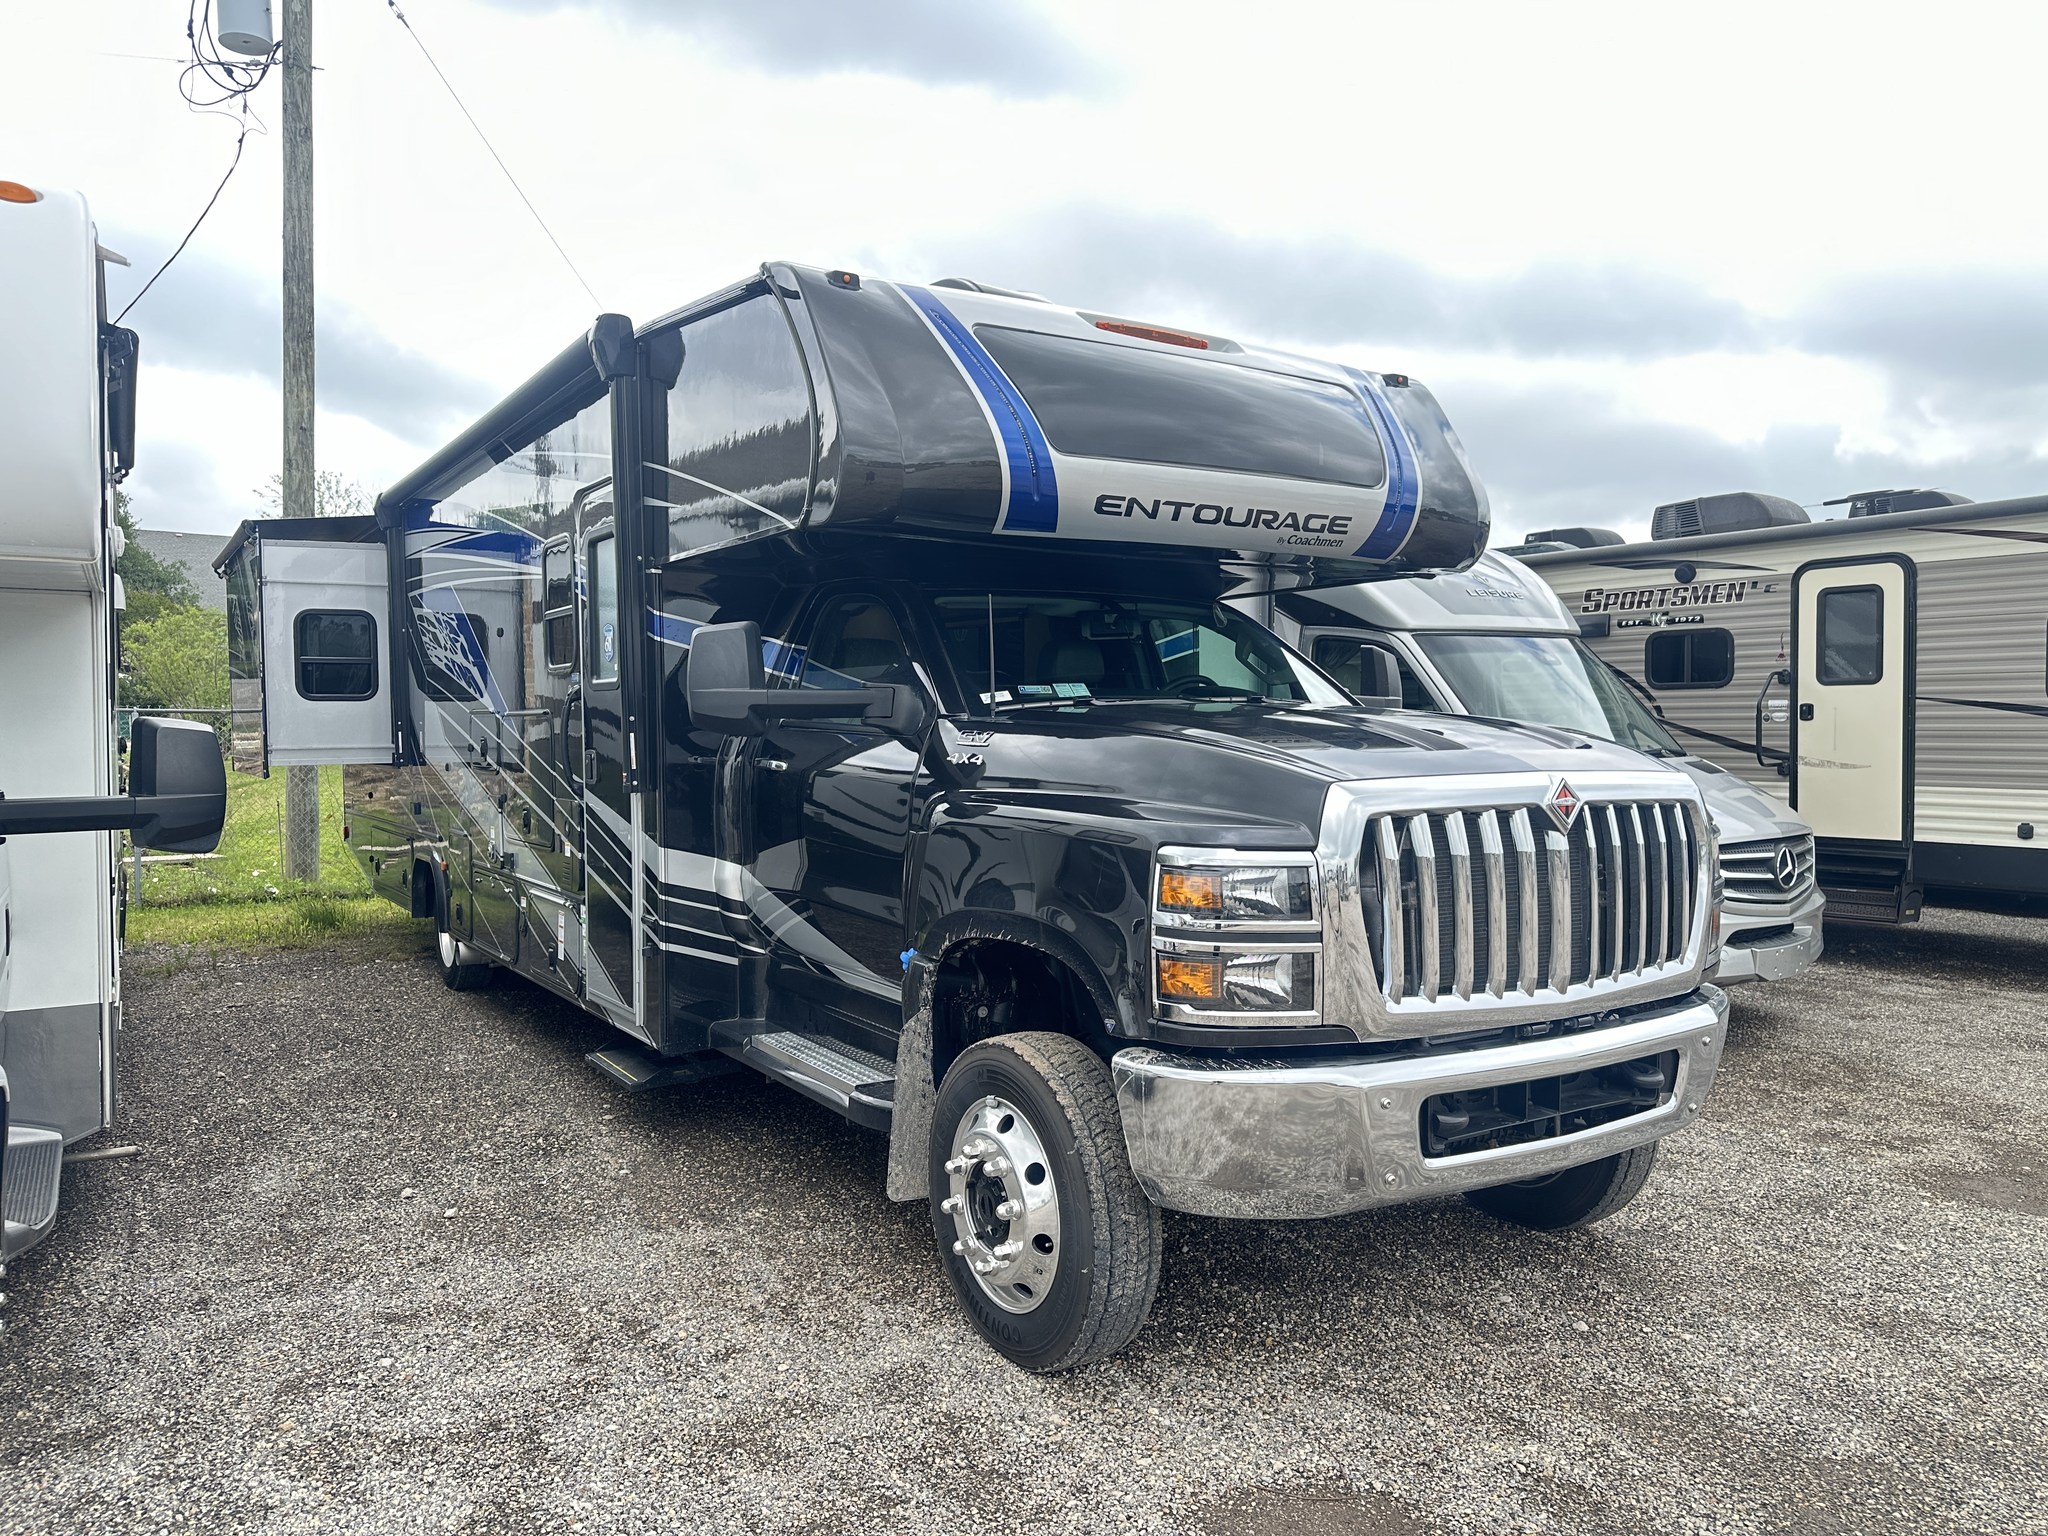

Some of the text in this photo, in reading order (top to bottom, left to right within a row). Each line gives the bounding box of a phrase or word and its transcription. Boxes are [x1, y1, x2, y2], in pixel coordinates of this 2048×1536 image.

[1093, 493, 1353, 535] ENTOURAGE
[1287, 534, 1344, 548] Coachmen
[1465, 588, 1525, 600] LEISURE
[1580, 580, 1780, 615] SPORTSMEN LE
[1621, 619, 1643, 627] EST.
[1674, 615, 1701, 623] 1972
[946, 752, 984, 766] 4X4
